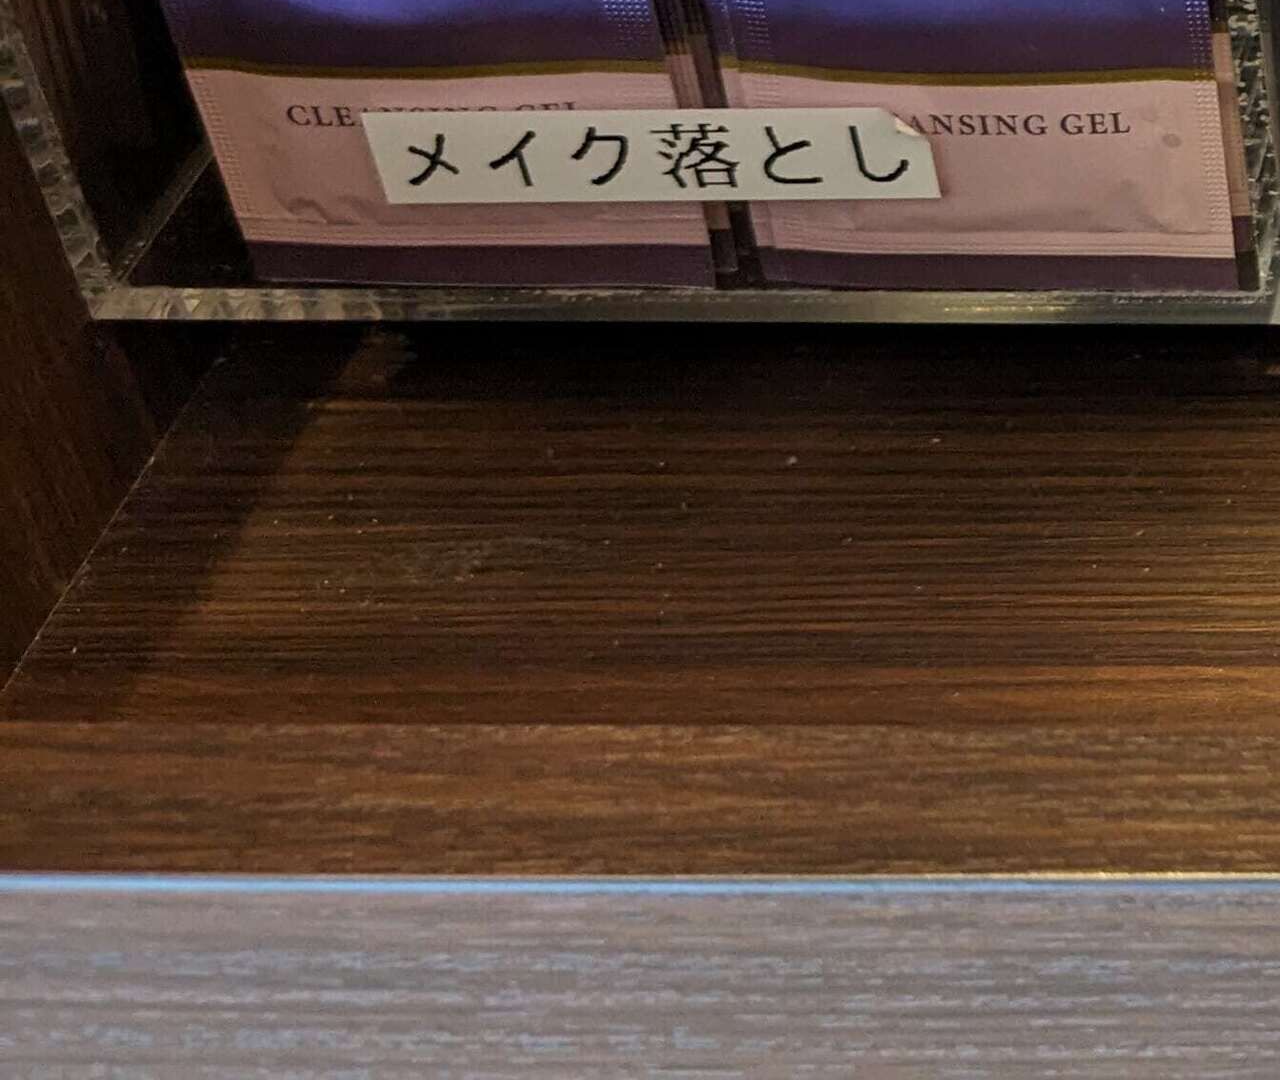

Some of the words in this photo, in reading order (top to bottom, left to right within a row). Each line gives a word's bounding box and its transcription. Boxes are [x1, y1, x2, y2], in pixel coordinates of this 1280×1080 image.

[905, 113, 1049, 137] ANSING
[1060, 111, 1131, 135] GEL
[408, 124, 911, 189] メイク落とし
